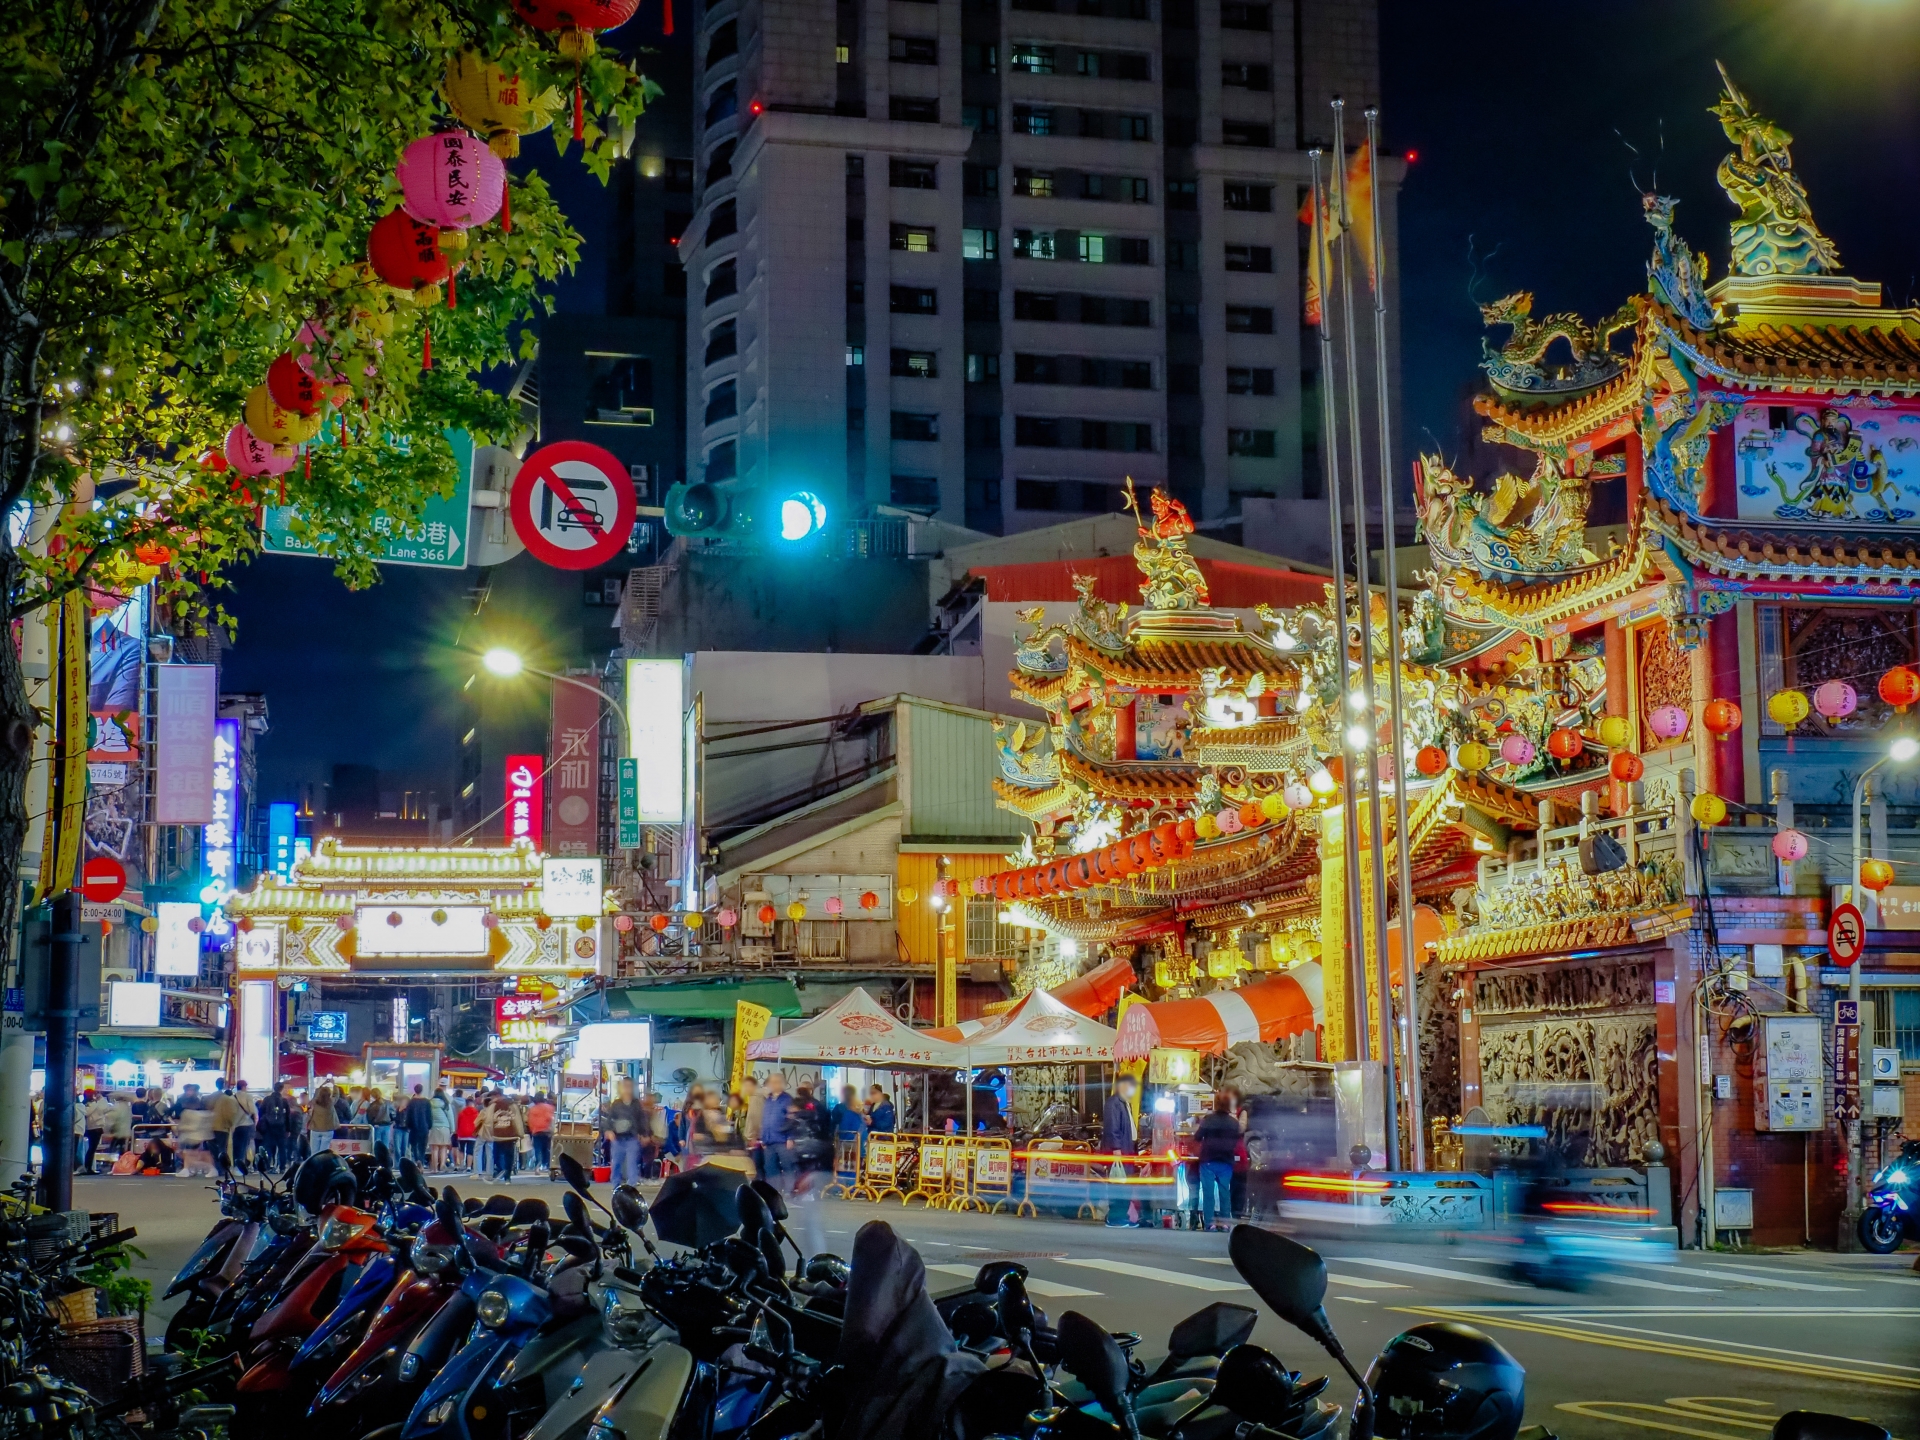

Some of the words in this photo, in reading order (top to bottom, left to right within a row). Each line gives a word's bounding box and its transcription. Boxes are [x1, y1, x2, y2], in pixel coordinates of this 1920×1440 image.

[443, 137, 469, 207] 國泰民安
[389, 545, 417, 559] Lane
[420, 548, 445, 561] 366
[560, 728, 590, 789] 永和
[622, 767, 635, 817] 饒河街
[837, 1044, 933, 1061] 台北市松山慈祐宮
[1836, 1027, 1846, 1080] 河濱自行車道
[1848, 1028, 1859, 1080] 彩虹橋
[1050, 1162, 1085, 1177] 請勿停車
